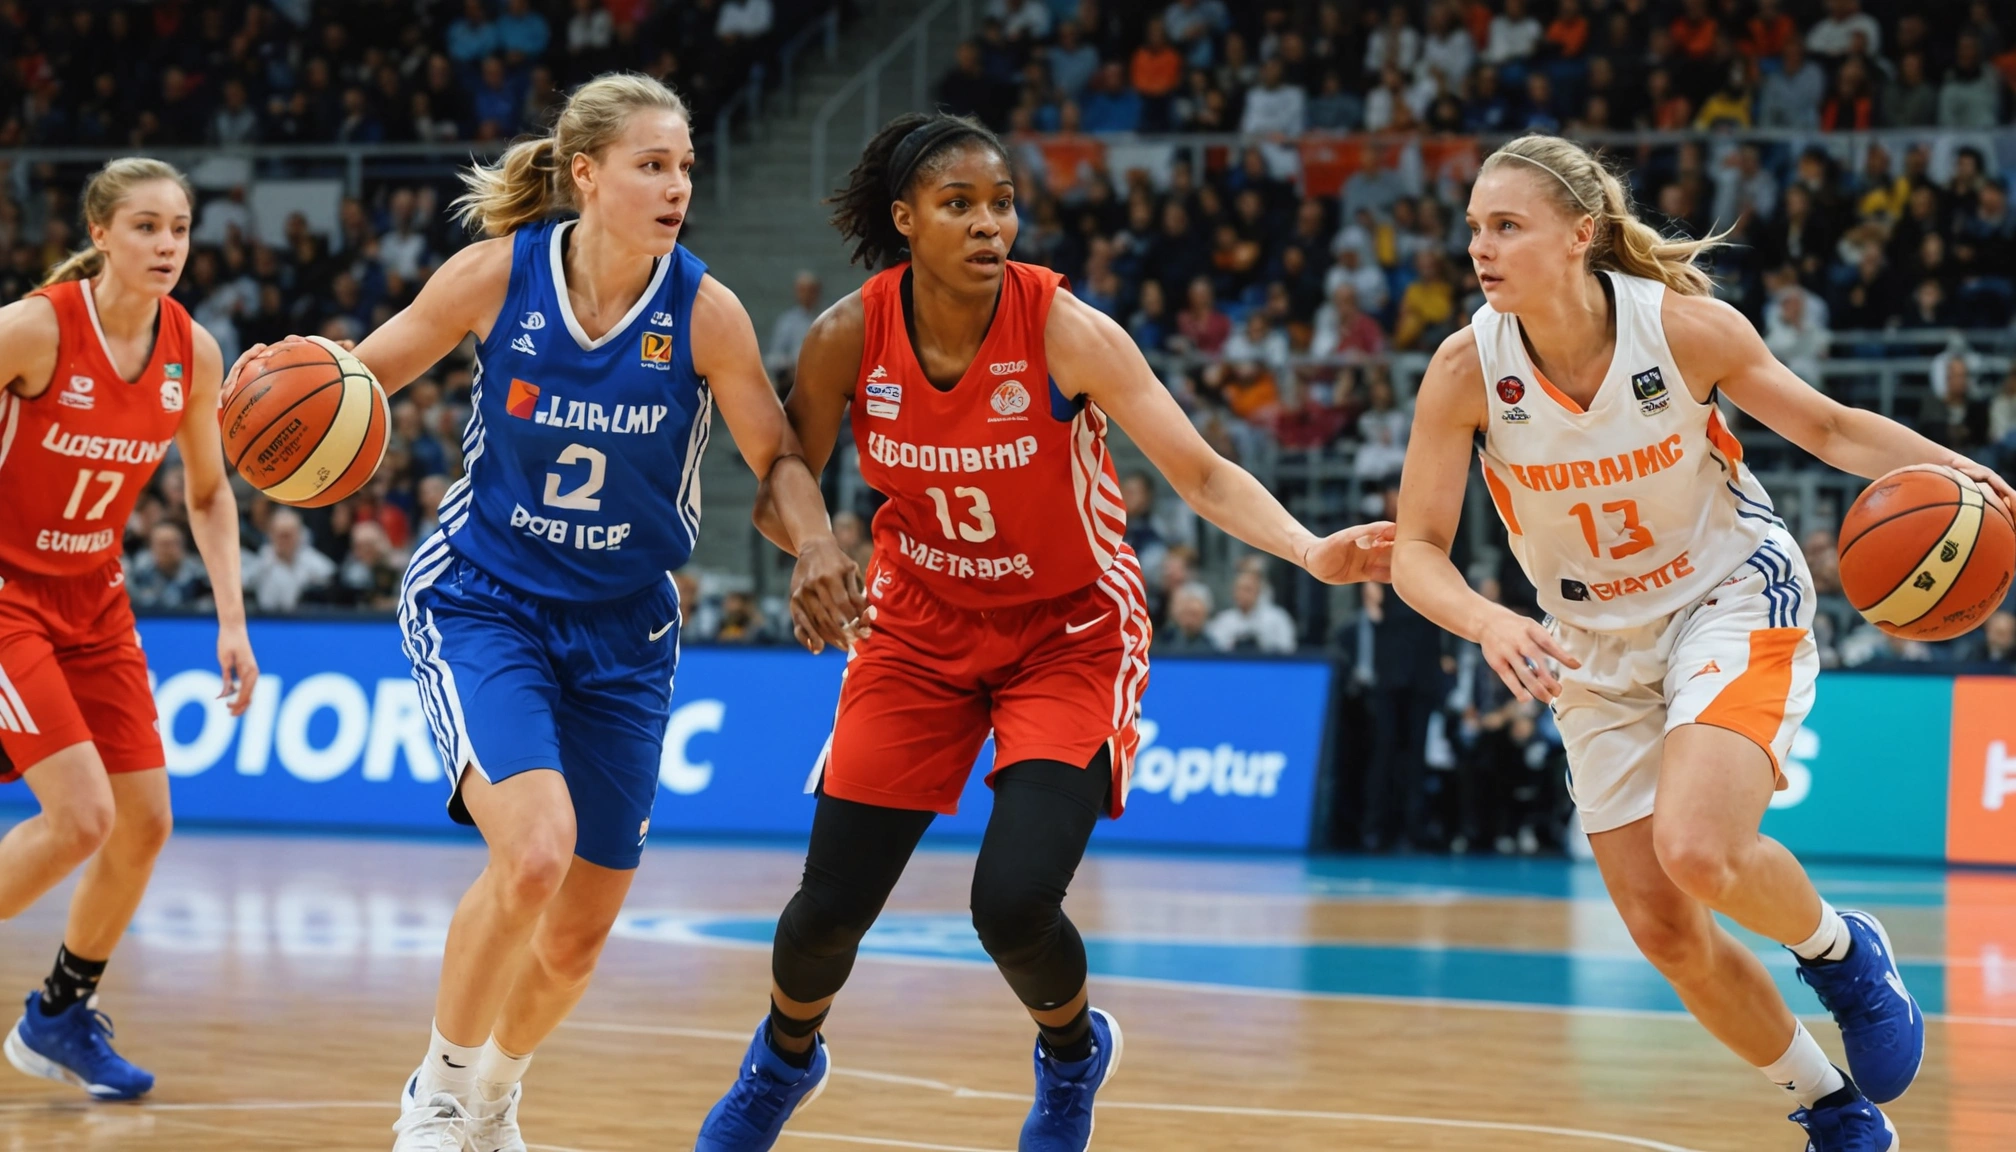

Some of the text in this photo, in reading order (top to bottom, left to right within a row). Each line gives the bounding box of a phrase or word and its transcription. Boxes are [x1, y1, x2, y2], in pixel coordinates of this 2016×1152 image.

[62, 468, 125, 521] 17
[543, 443, 607, 512] 2
[925, 486, 997, 543] 13
[1568, 499, 1655, 560] 13
